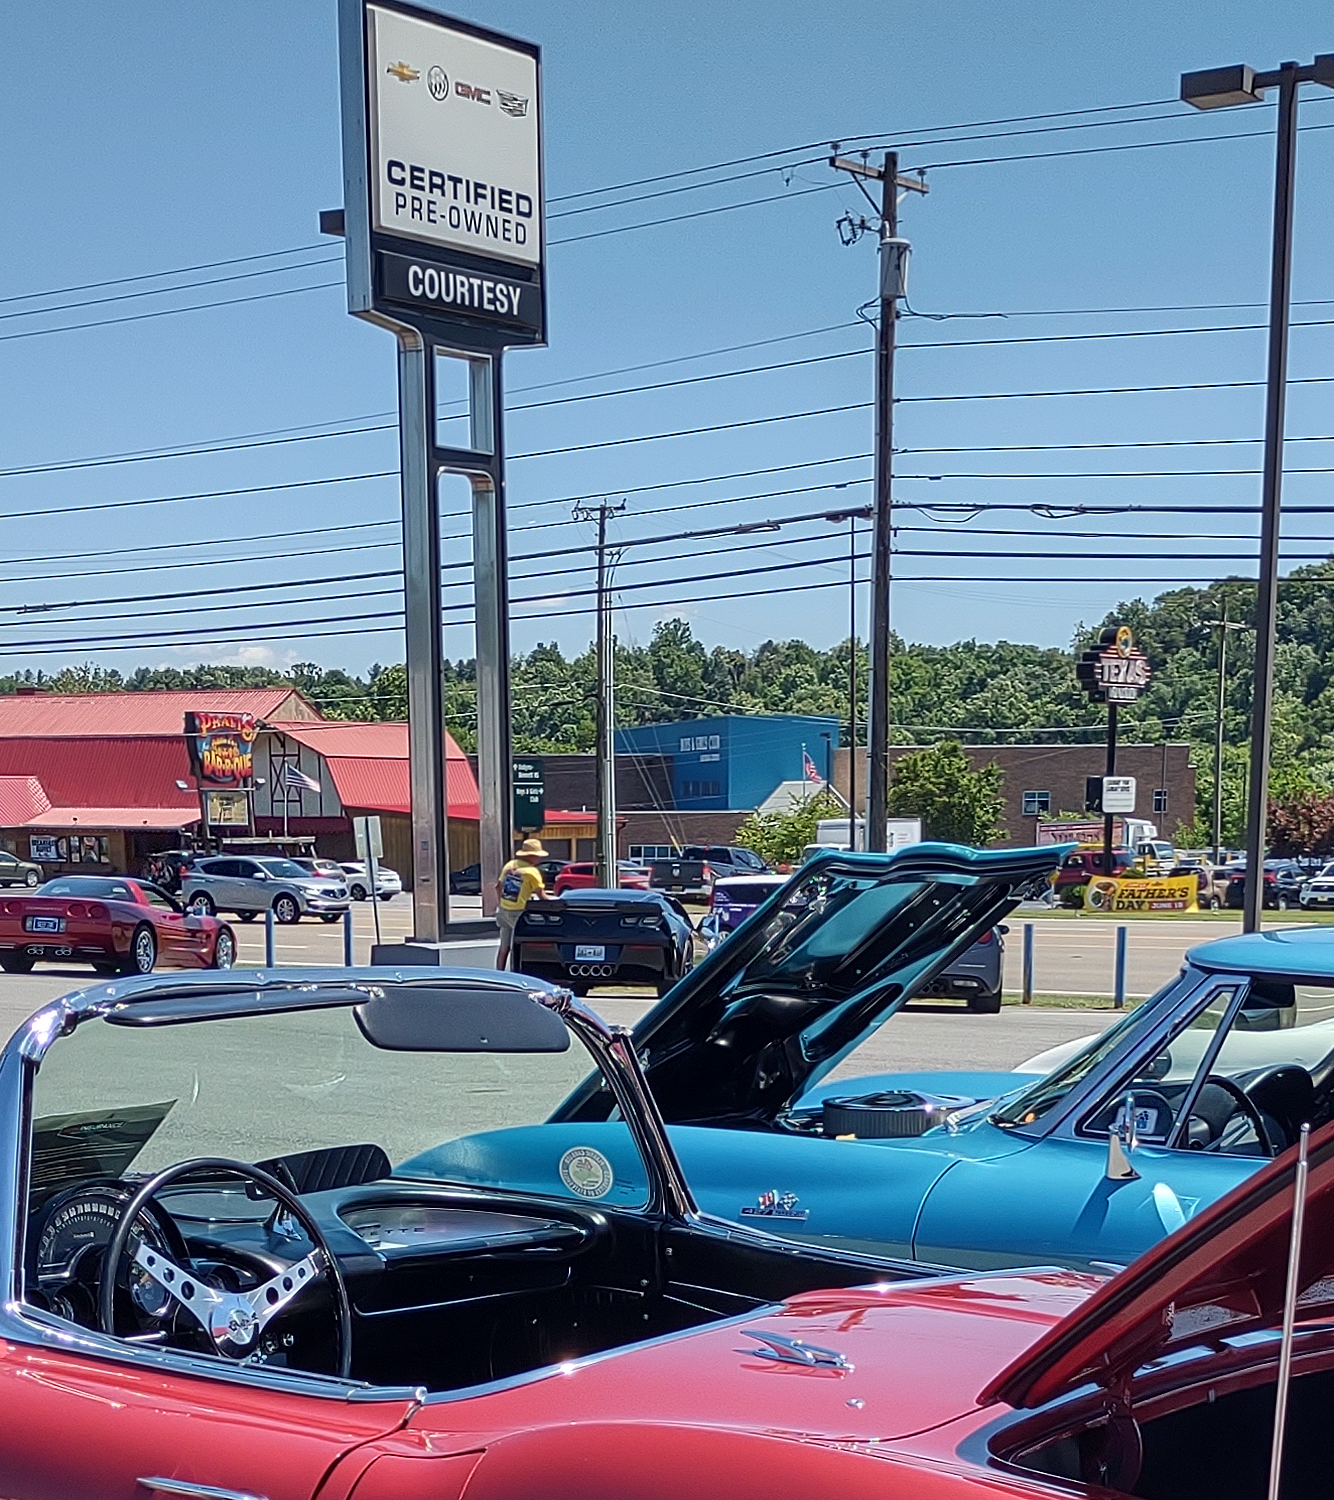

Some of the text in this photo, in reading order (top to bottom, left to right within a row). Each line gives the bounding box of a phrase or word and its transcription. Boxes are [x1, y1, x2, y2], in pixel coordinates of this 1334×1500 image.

[454, 81, 491, 105] GMC
[386, 159, 533, 219] CERTIFIED
[394, 191, 527, 246] PRE-OWNED
[408, 264, 521, 316] COURTESY
[1100, 658, 1147, 685] TEXAS
[1116, 900, 1145, 911] DAY
[1117, 887, 1189, 899] FATHER'S
